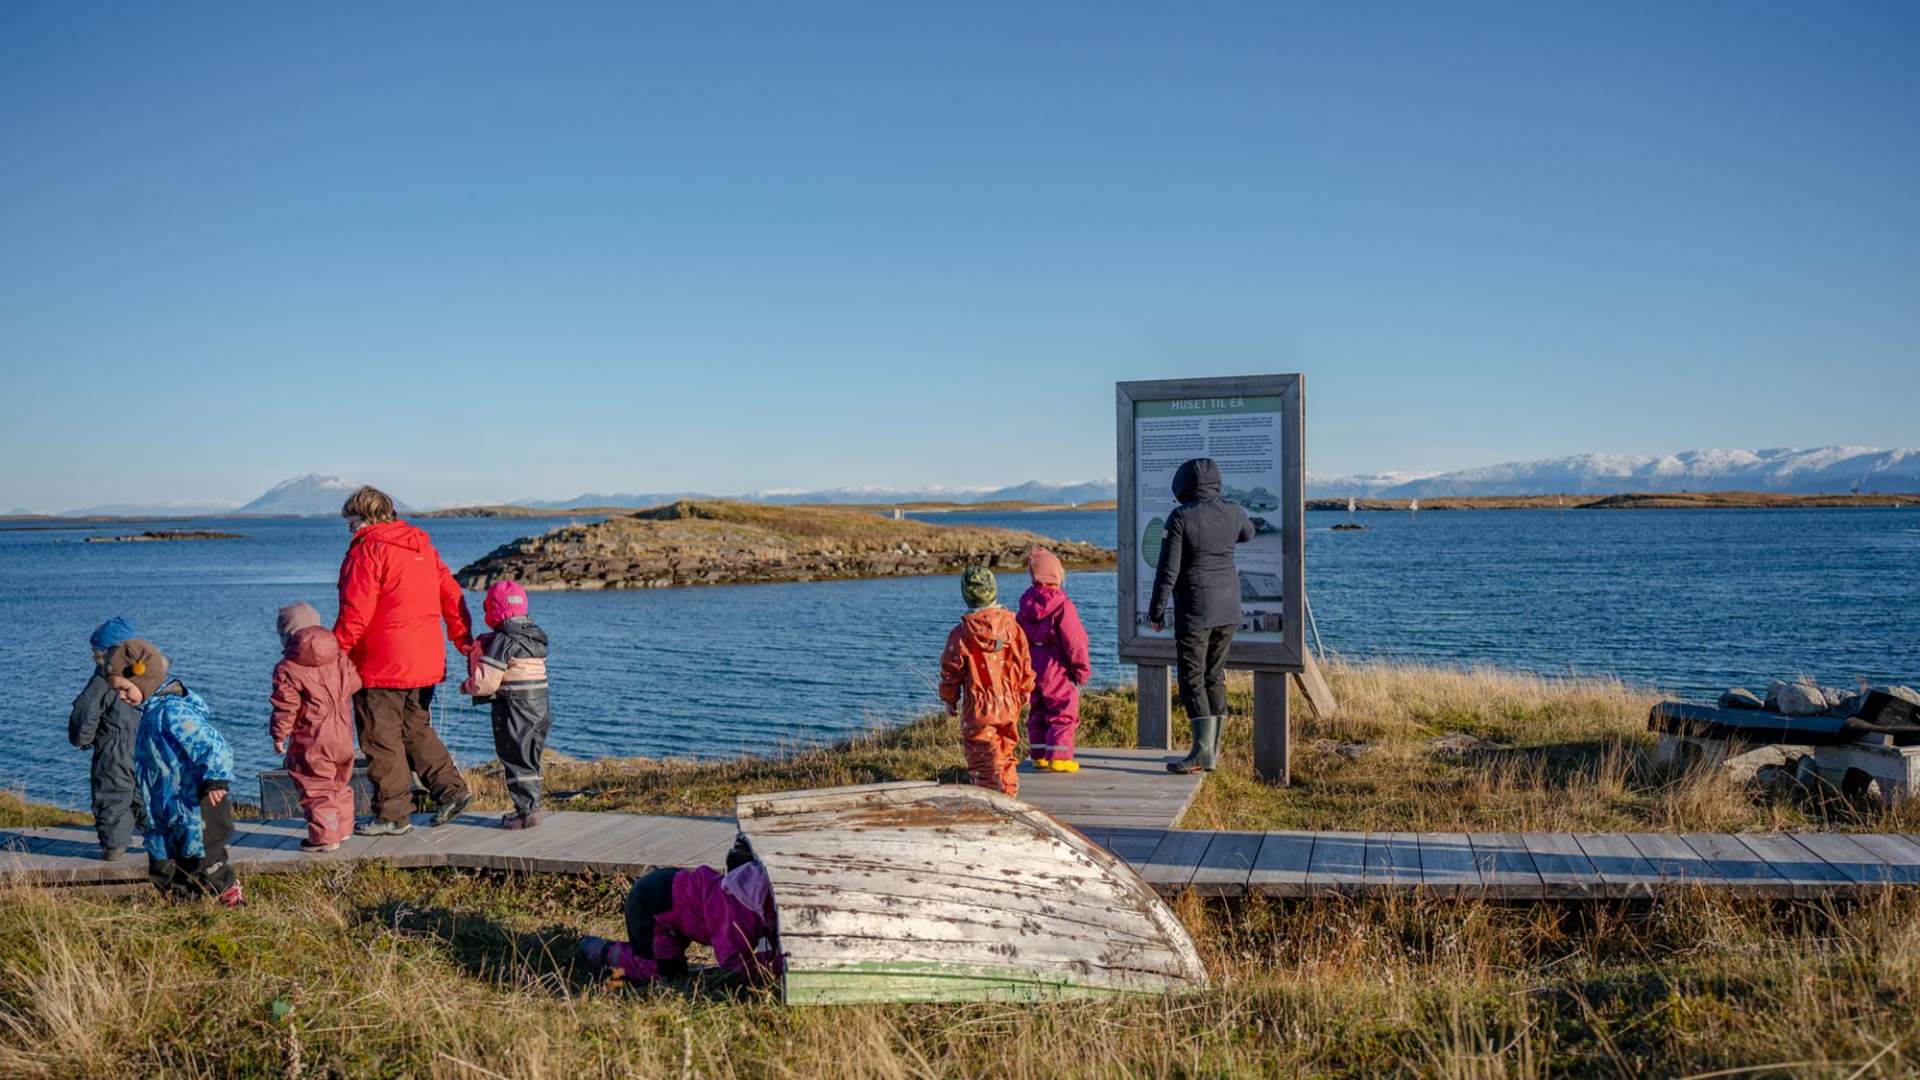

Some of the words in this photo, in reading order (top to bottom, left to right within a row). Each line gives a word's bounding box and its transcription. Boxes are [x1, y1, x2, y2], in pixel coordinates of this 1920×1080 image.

[1171, 399, 1206, 410] HUSET
[1211, 399, 1227, 409] TIL
[1230, 398, 1245, 408] EA
